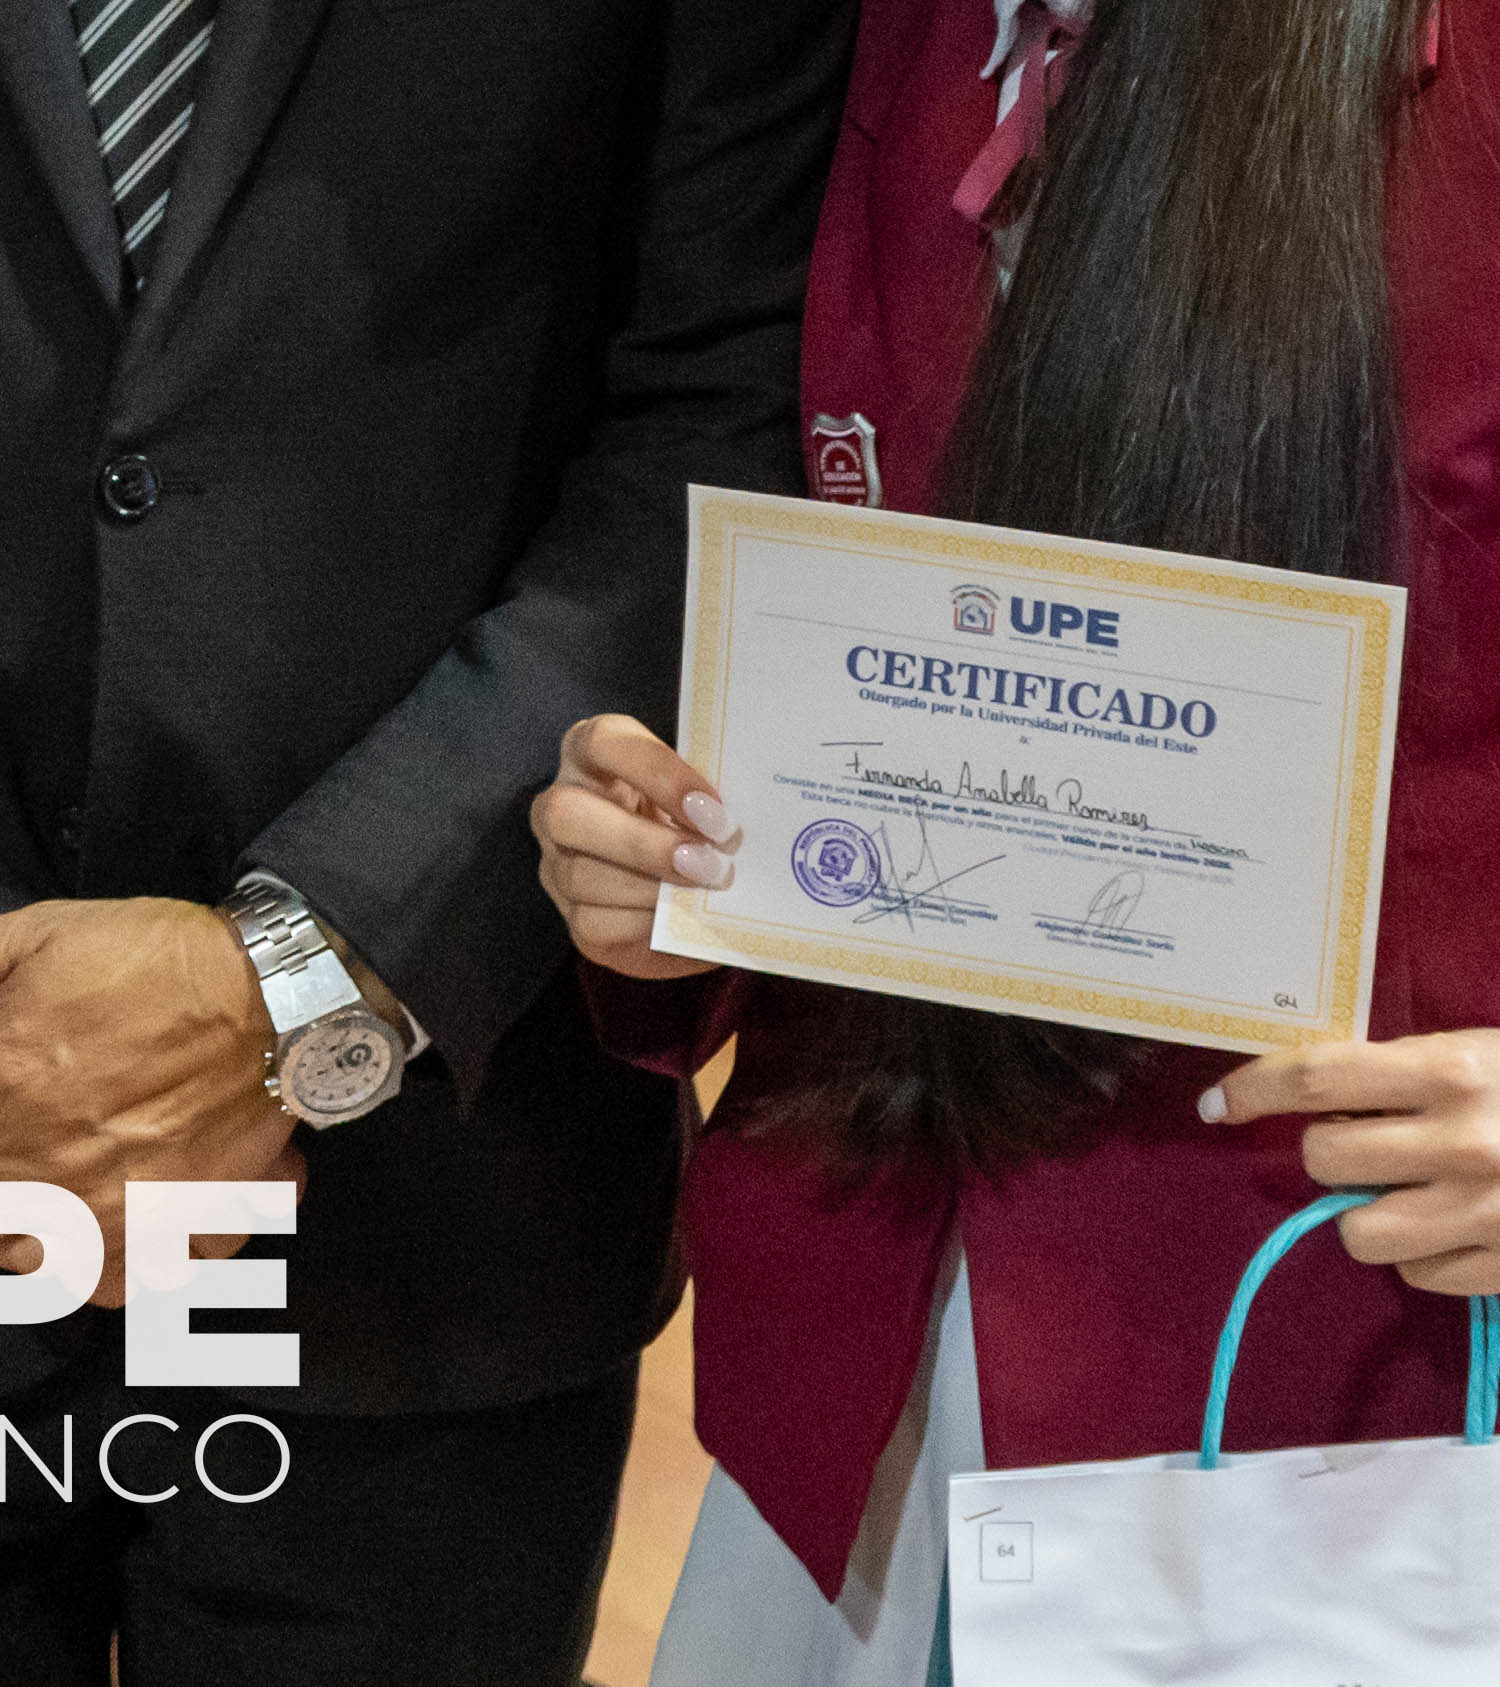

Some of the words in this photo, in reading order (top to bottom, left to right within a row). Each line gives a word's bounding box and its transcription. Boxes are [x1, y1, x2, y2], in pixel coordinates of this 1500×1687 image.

[1008, 596, 1120, 648] UPE
[844, 643, 1218, 740] CERTIFICADO
[858, 687, 927, 712] Otorgado
[930, 698, 956, 717] por
[960, 703, 973, 718] la
[977, 706, 1068, 733] Universidad
[1072, 721, 1131, 743] Privada
[1135, 731, 1158, 747] del
[1163, 736, 1198, 754] Este
[821, 742, 943, 793] Fernanda
[953, 761, 1049, 810] Anabella
[997, 1544, 1015, 1558] 64
